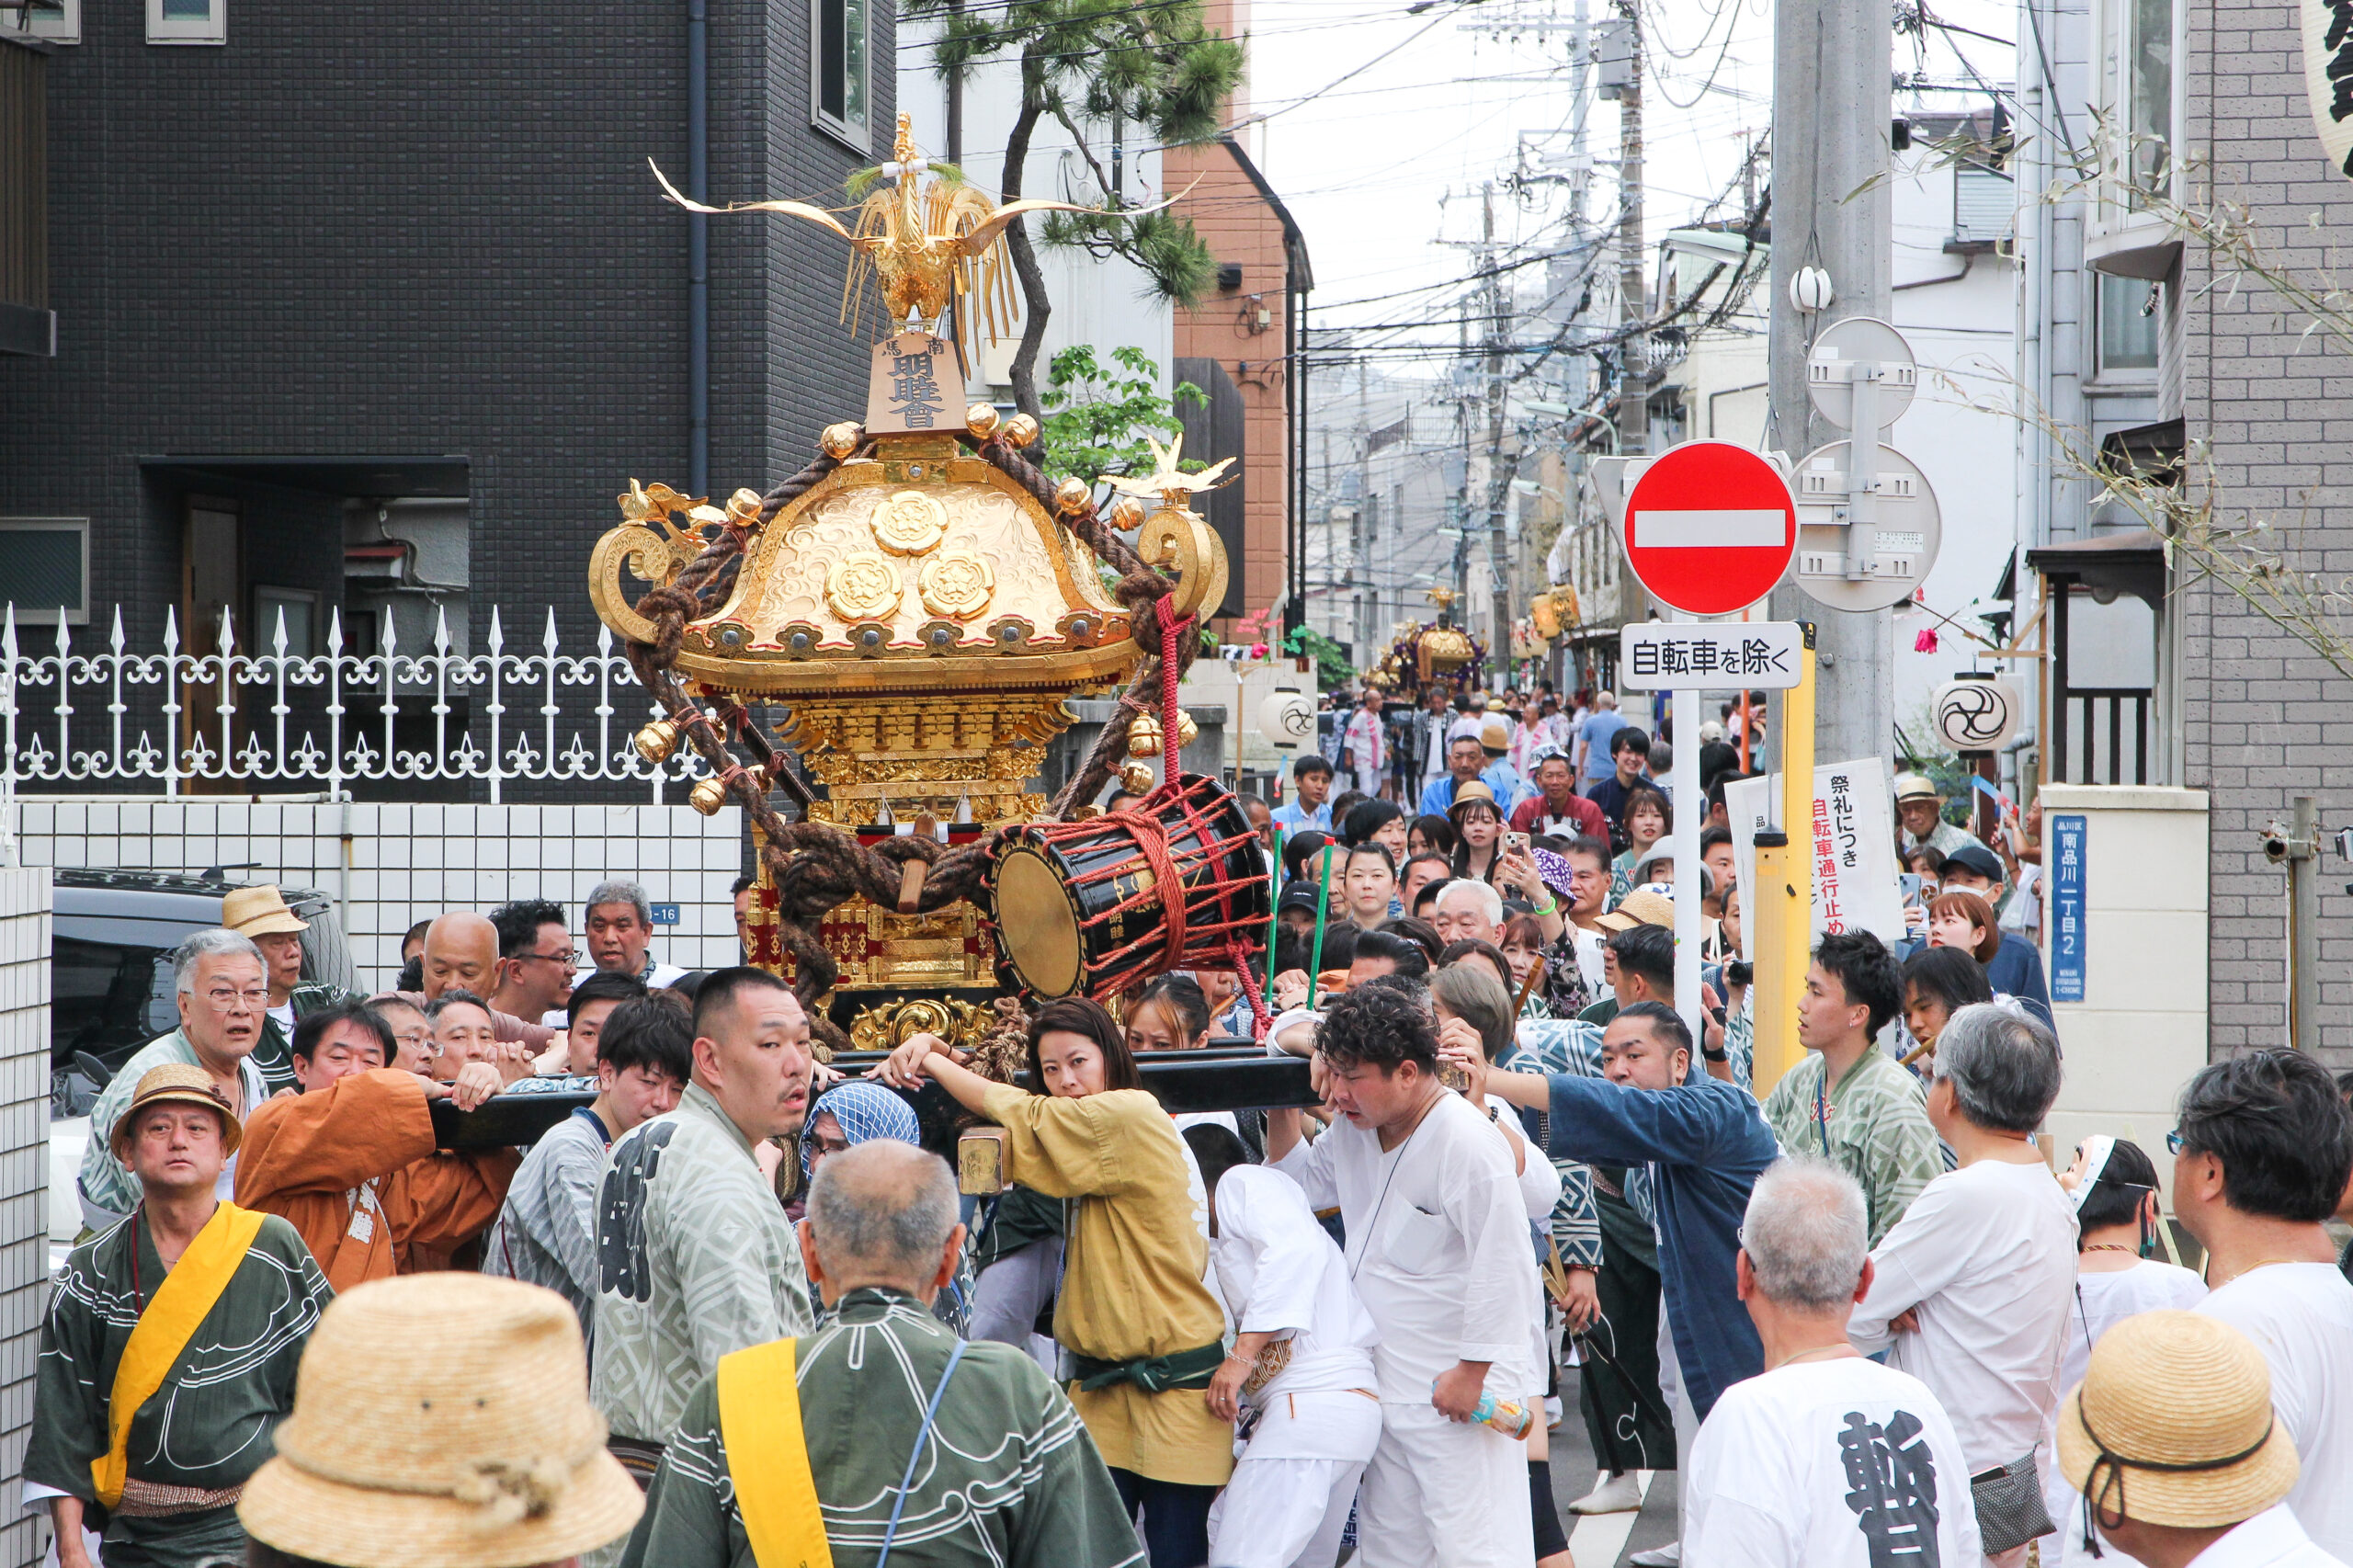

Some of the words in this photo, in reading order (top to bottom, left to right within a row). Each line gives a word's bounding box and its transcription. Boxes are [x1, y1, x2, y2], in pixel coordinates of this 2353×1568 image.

[925, 336, 945, 356] 南
[1633, 638, 1790, 676] 自転車を除く
[1830, 775, 1858, 869] 祭礼につき
[1813, 798, 1846, 936] 自転車通行止め
